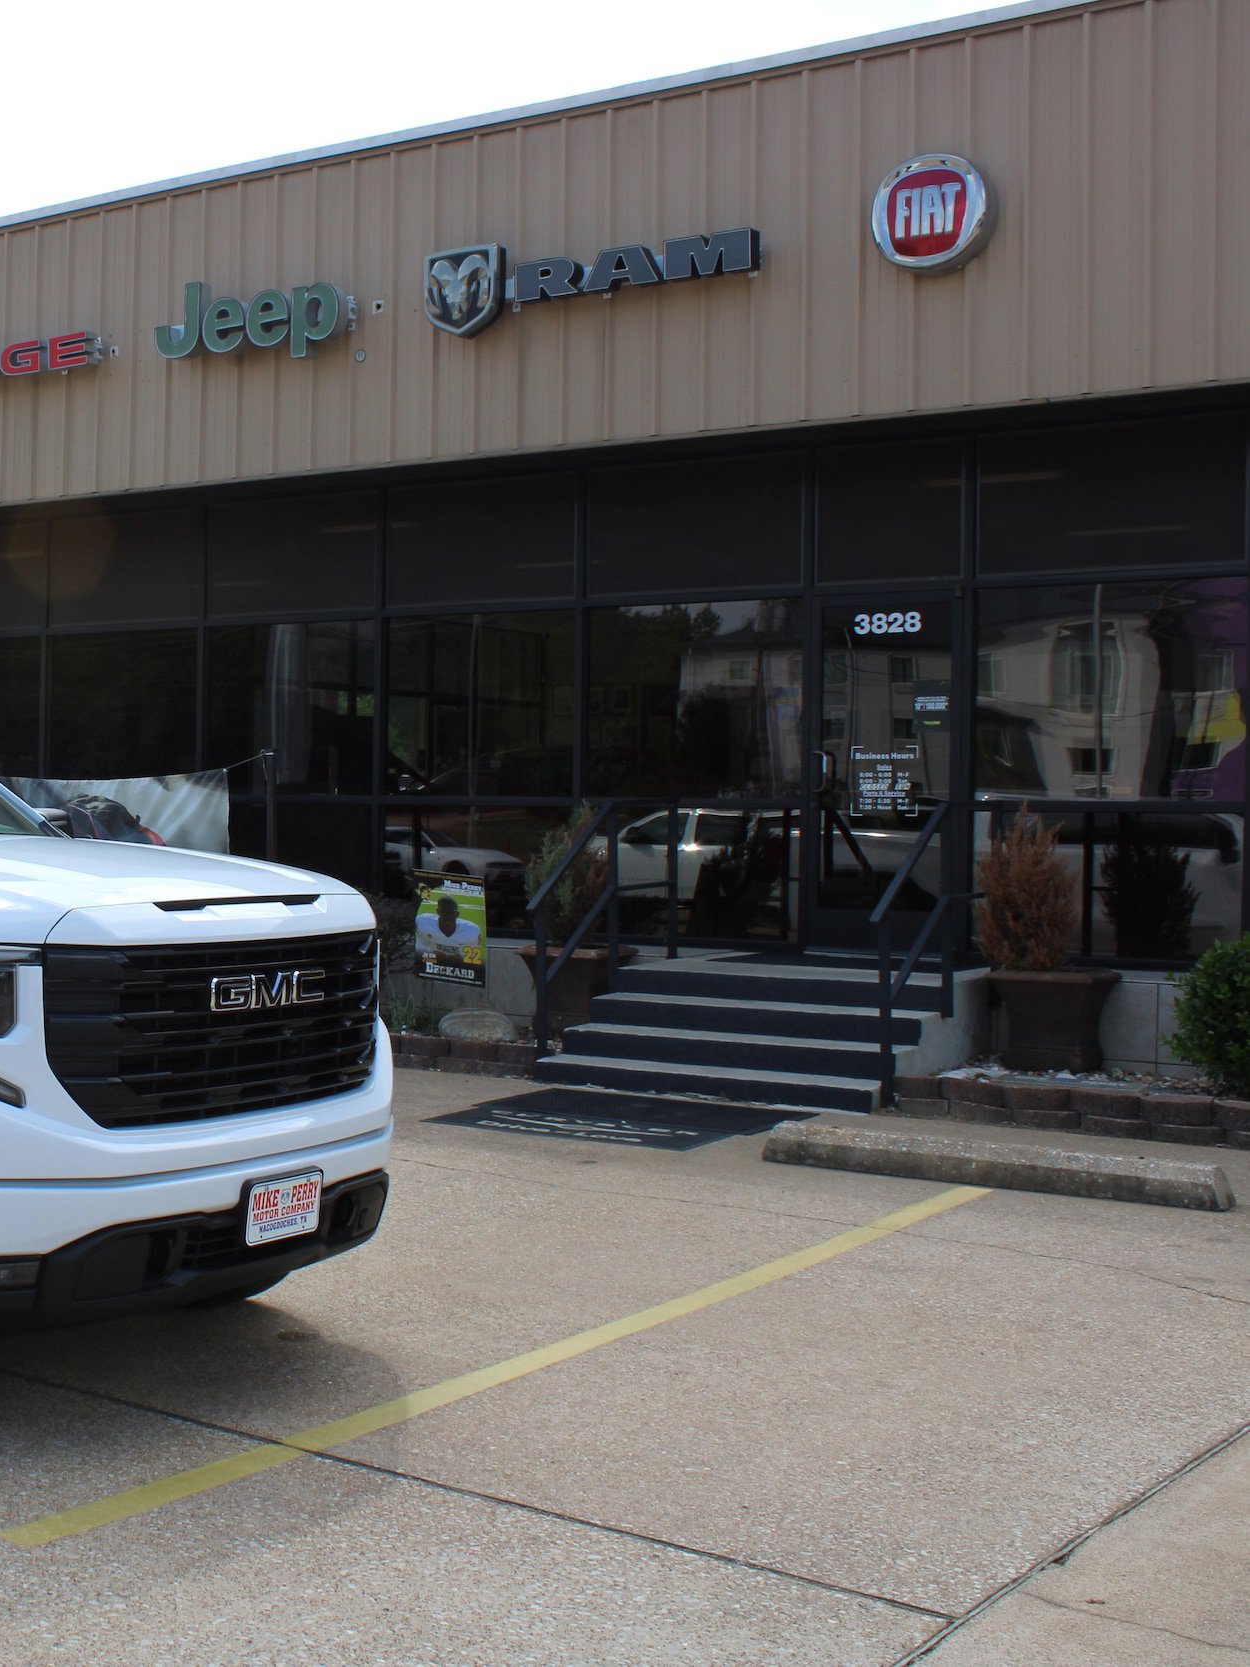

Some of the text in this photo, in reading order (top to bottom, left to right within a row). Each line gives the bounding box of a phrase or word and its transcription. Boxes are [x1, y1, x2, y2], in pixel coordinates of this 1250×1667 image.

[894, 182, 962, 240] FIAT
[514, 227, 755, 303] RAM
[154, 281, 340, 360] Jeep
[854, 611, 921, 635] 3828
[462, 945, 482, 965] 22
[210, 969, 326, 1012] GMC
[252, 1180, 319, 1212] MIKE PERRY
[253, 1200, 315, 1223] MOTOR COMPANY
[300, 1215, 307, 1224] TX
